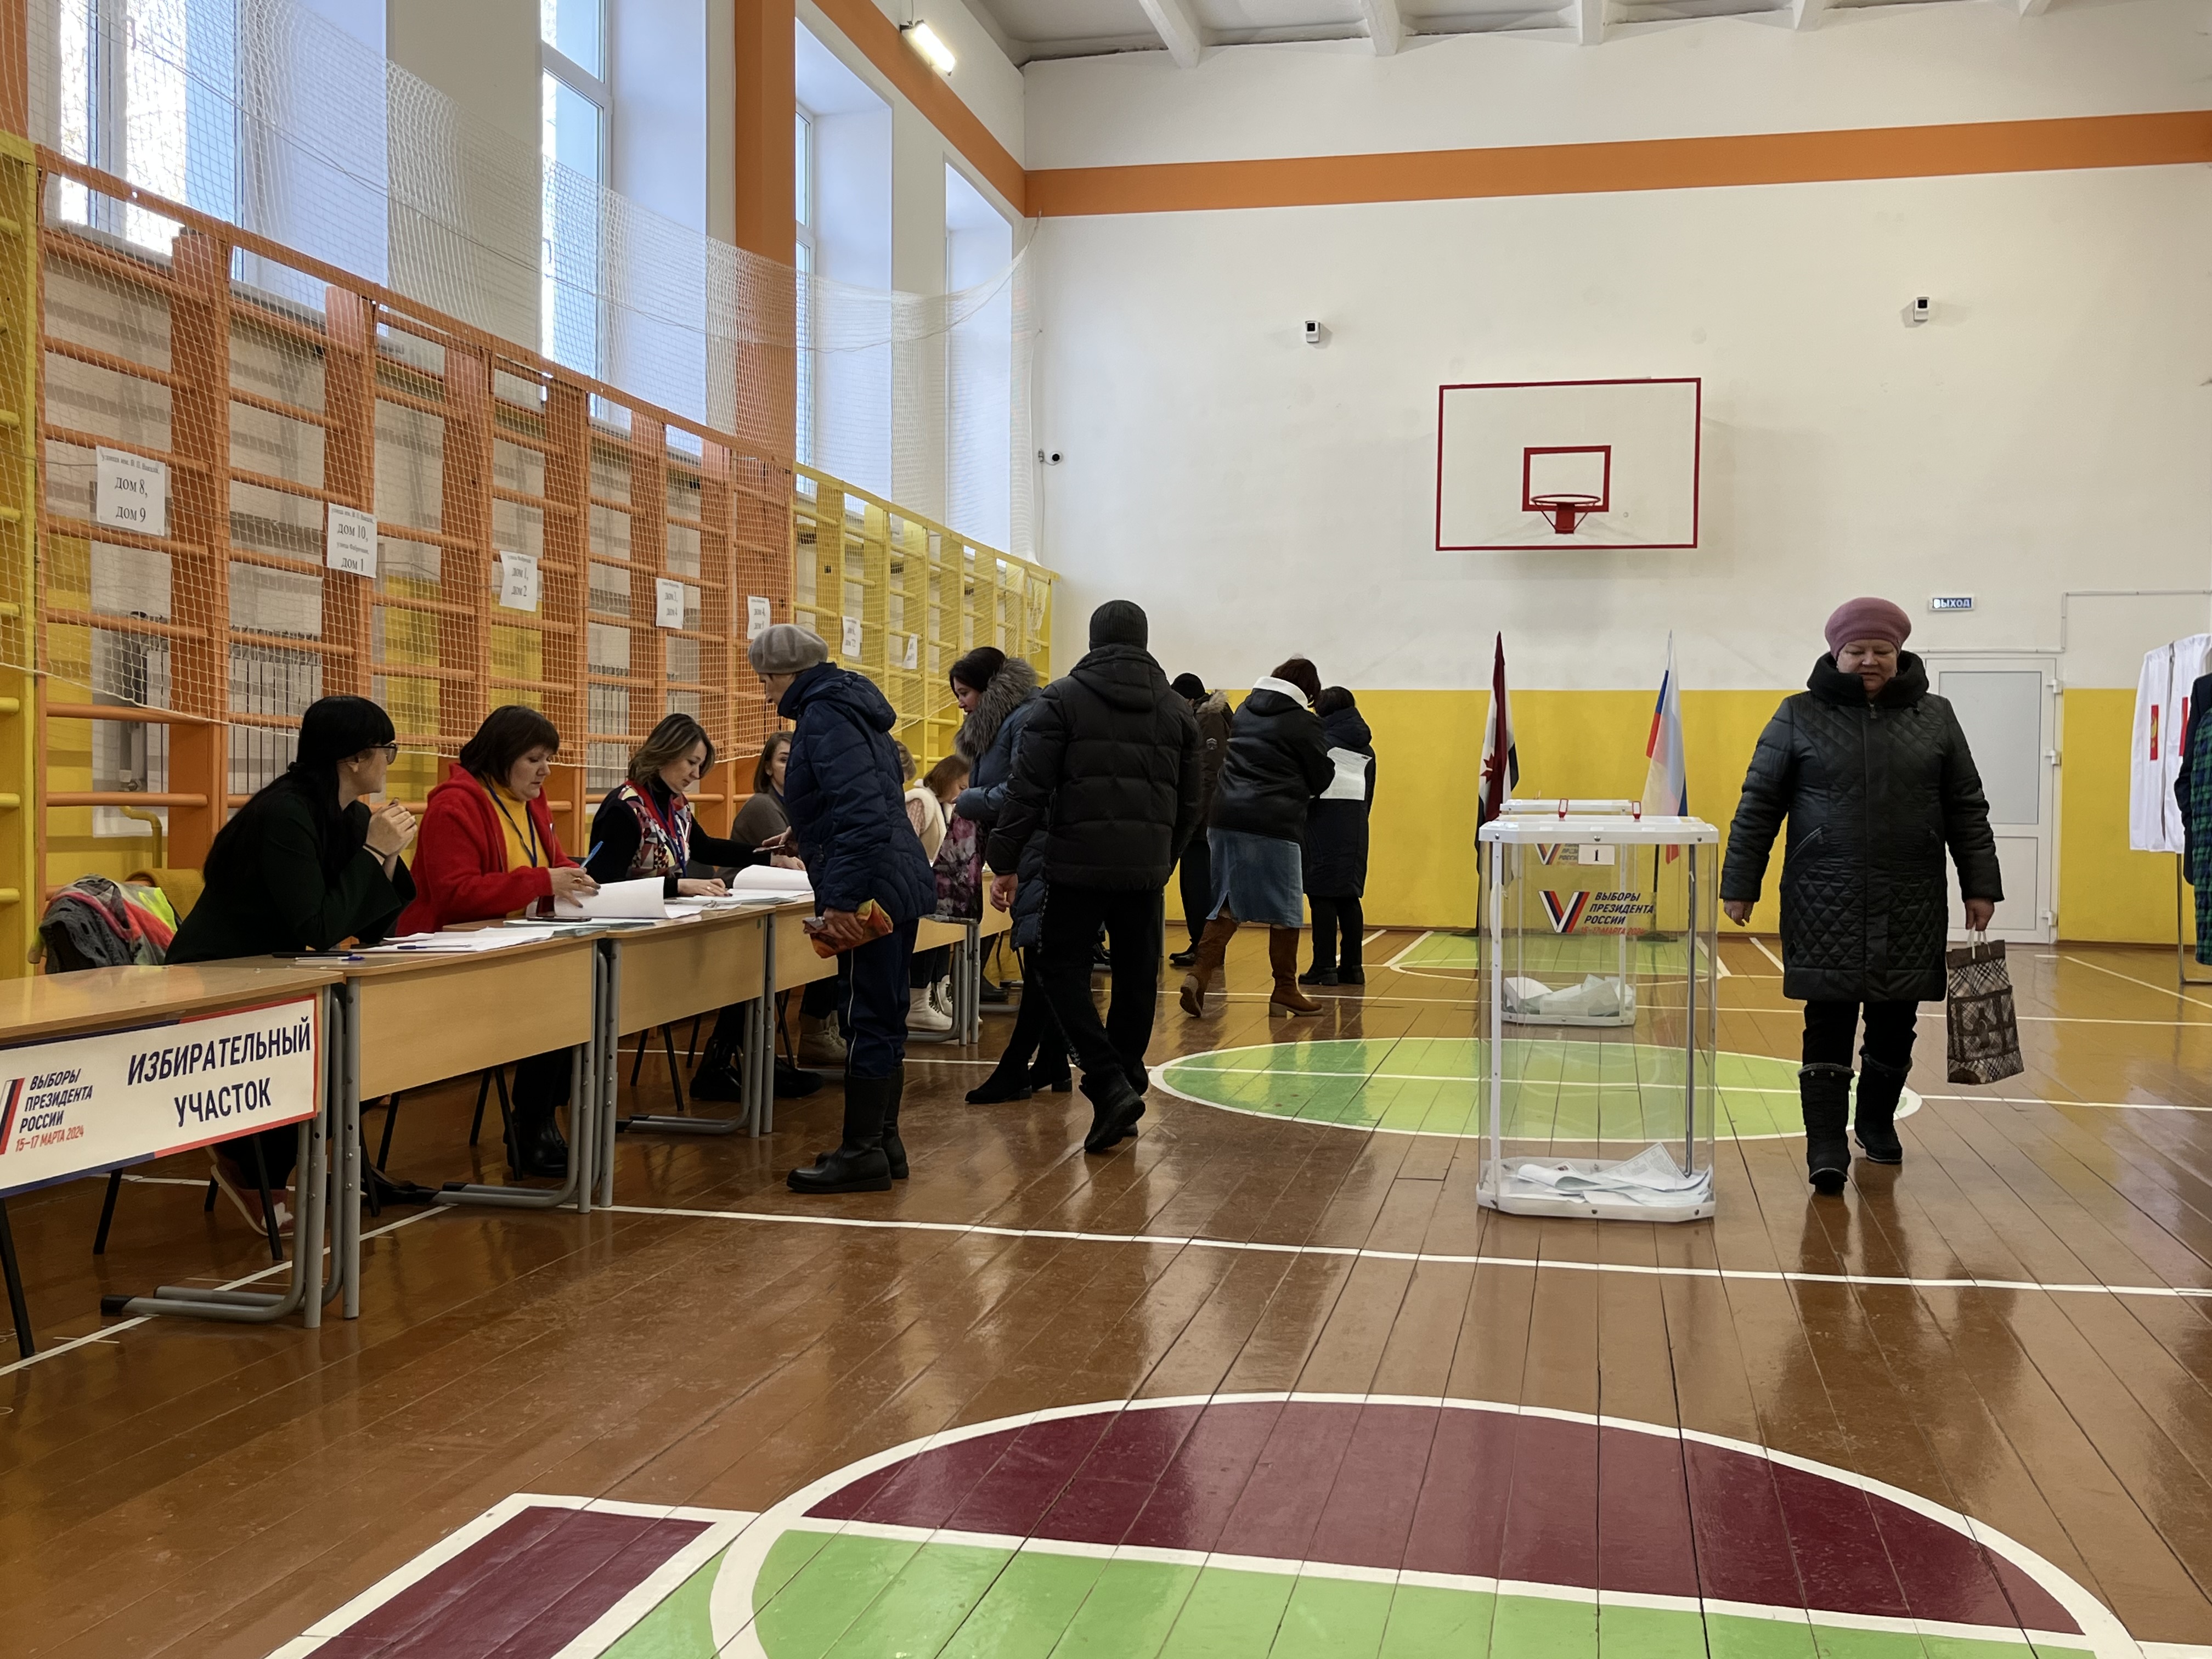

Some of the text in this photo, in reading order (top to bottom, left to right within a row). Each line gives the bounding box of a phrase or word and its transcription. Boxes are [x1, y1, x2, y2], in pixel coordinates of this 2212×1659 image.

[115, 477, 148, 498] дом 8,
[115, 506, 146, 522] дом 9
[337, 523, 369, 542] дом 10,
[341, 557, 364, 572] дом 1
[523, 585, 527, 597] 2
[1594, 849, 1600, 862] 1
[1595, 892, 1641, 901] ВЫБОРЫ
[1589, 904, 1654, 914] ПРЕЗИДЕНТА
[1584, 915, 1626, 924] РОССИИ
[127, 1015, 311, 1086] ИЗБИРАТЕЛЬНЫЙ
[30, 1068, 82, 1091] ВЫБОРЫ
[24, 1085, 93, 1112] ПРЕЗИДЕНТА
[174, 1077, 272, 1127] УЧАСТОК
[19, 1110, 65, 1133] РОССИИ
[40, 1129, 65, 1147] МАРТА
[66, 1125, 84, 1141] 2024
